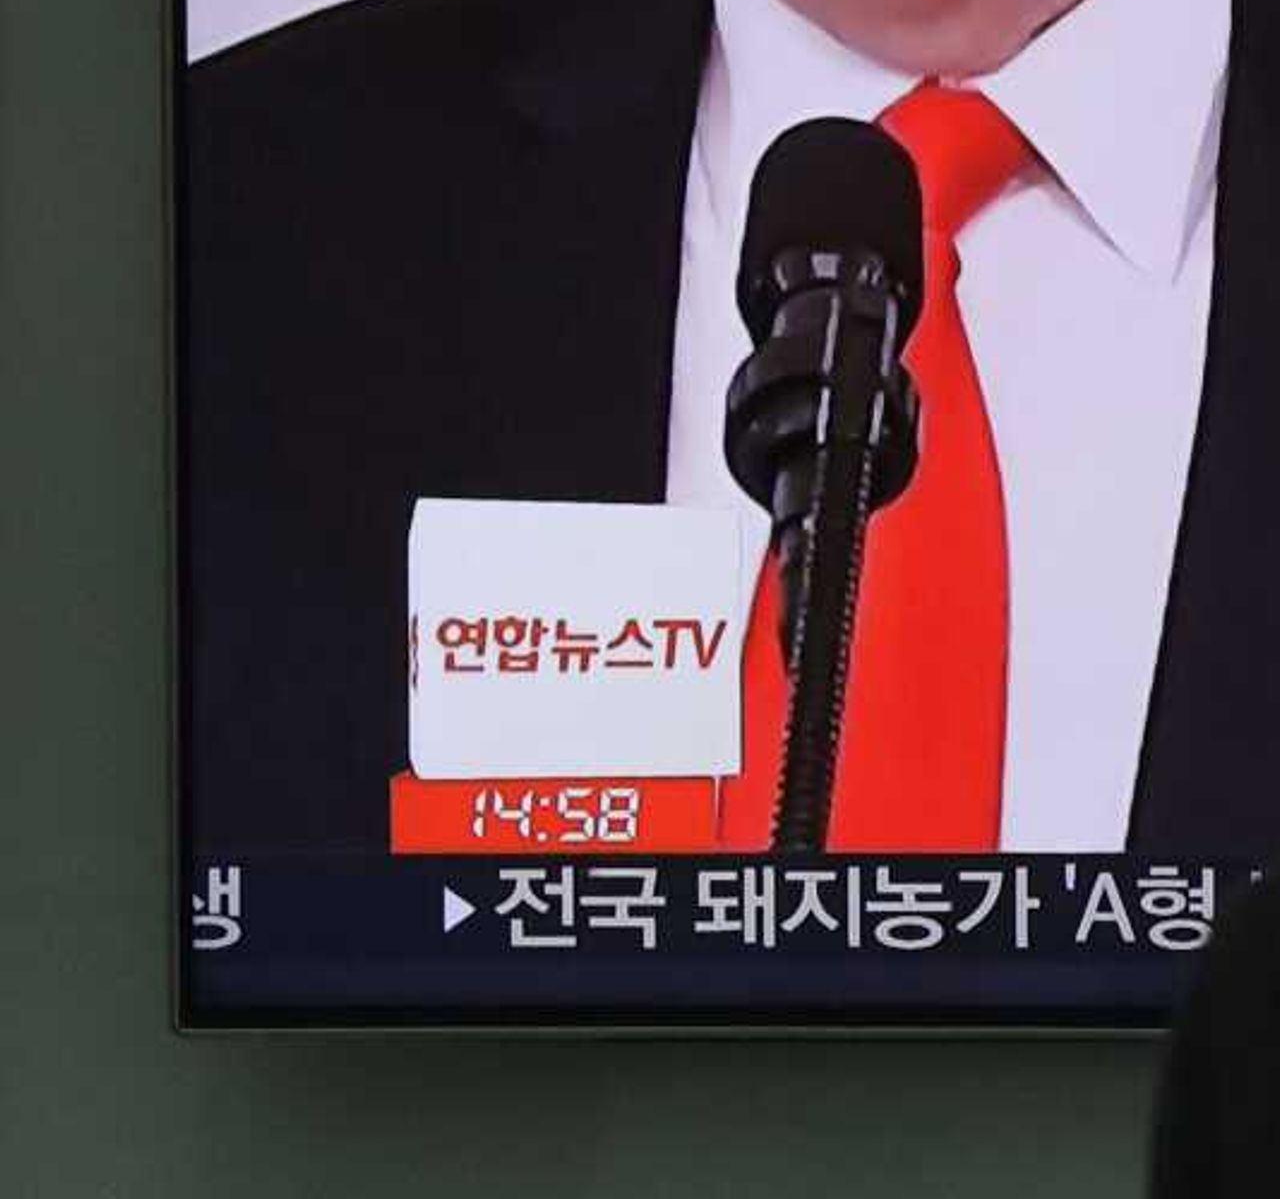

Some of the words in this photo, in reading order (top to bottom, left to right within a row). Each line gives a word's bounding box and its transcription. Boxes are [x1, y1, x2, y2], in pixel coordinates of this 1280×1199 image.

[436, 615, 728, 673] 연합뉴스TV
[473, 787, 639, 842] 14:58
[495, 866, 666, 949] 전국
[694, 866, 1041, 950] 돼지농가
